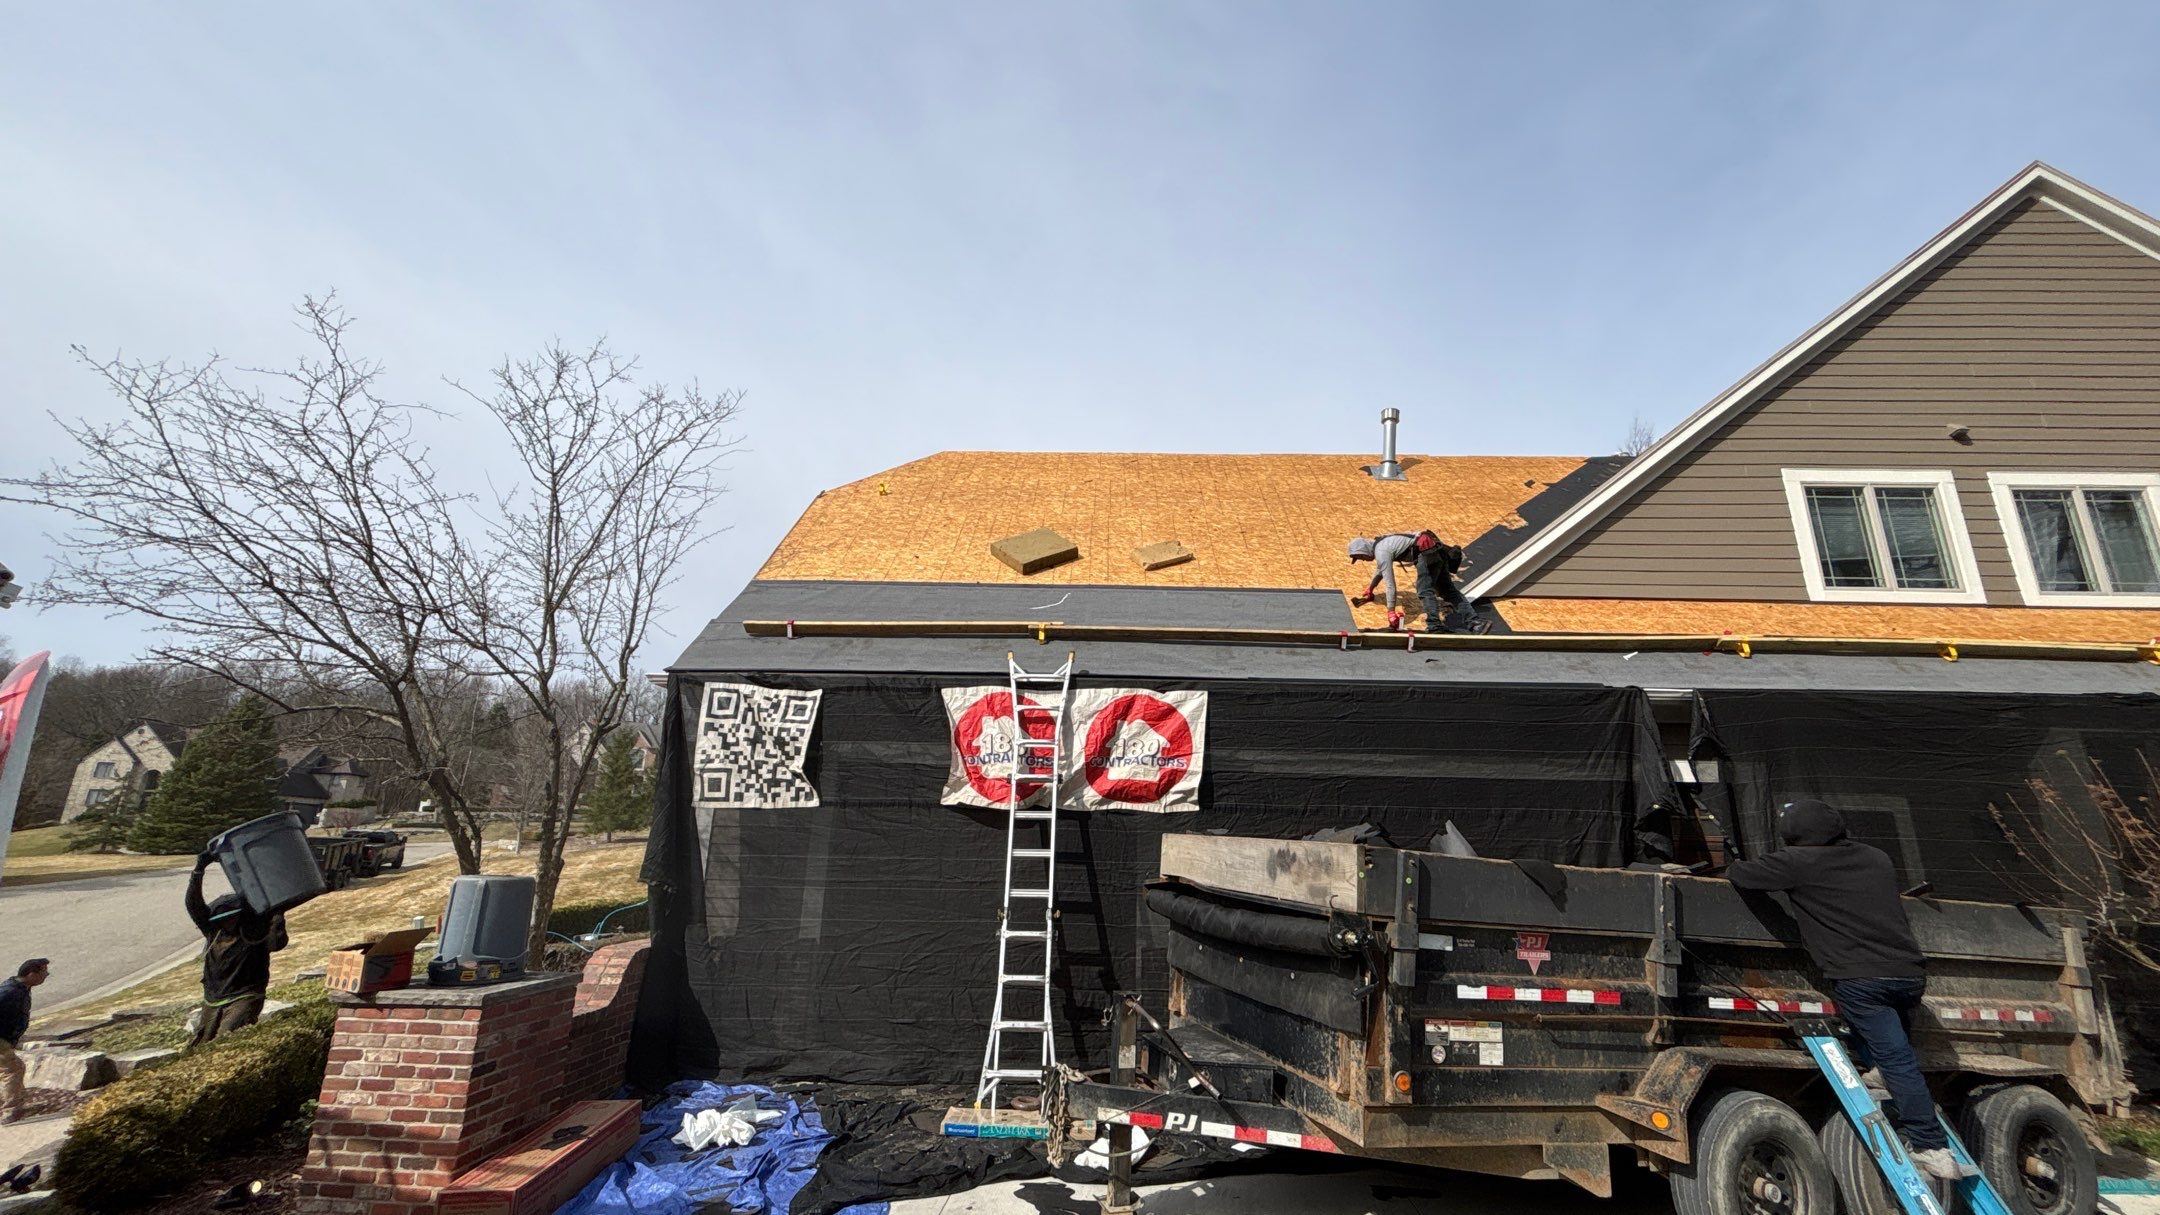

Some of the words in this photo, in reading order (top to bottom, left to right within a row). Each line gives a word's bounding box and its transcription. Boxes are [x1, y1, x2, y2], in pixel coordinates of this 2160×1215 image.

[1115, 738, 1160, 758] 180
[963, 753, 1055, 766] ONTRATORS
[1090, 756, 1186, 768] CONTRACTORS
[1526, 936, 1543, 948] PJ
[1165, 1111, 1198, 1132] PJ
